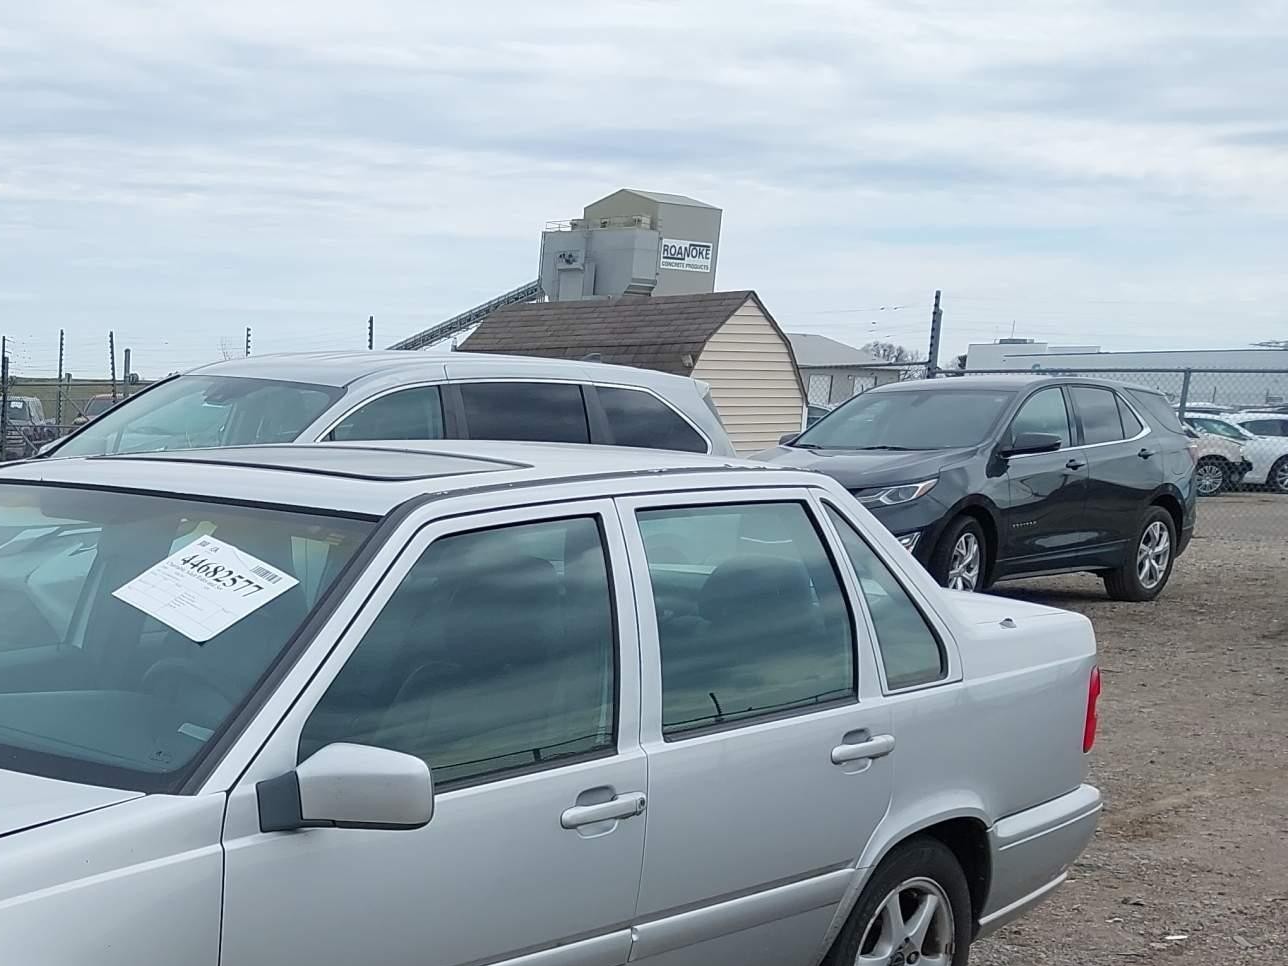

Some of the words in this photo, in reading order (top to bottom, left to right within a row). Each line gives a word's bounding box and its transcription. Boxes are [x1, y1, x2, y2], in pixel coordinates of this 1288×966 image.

[662, 244, 711, 260] ROANOKE
[685, 263, 709, 271] PRODUCTS
[181, 554, 264, 597] 44682577
